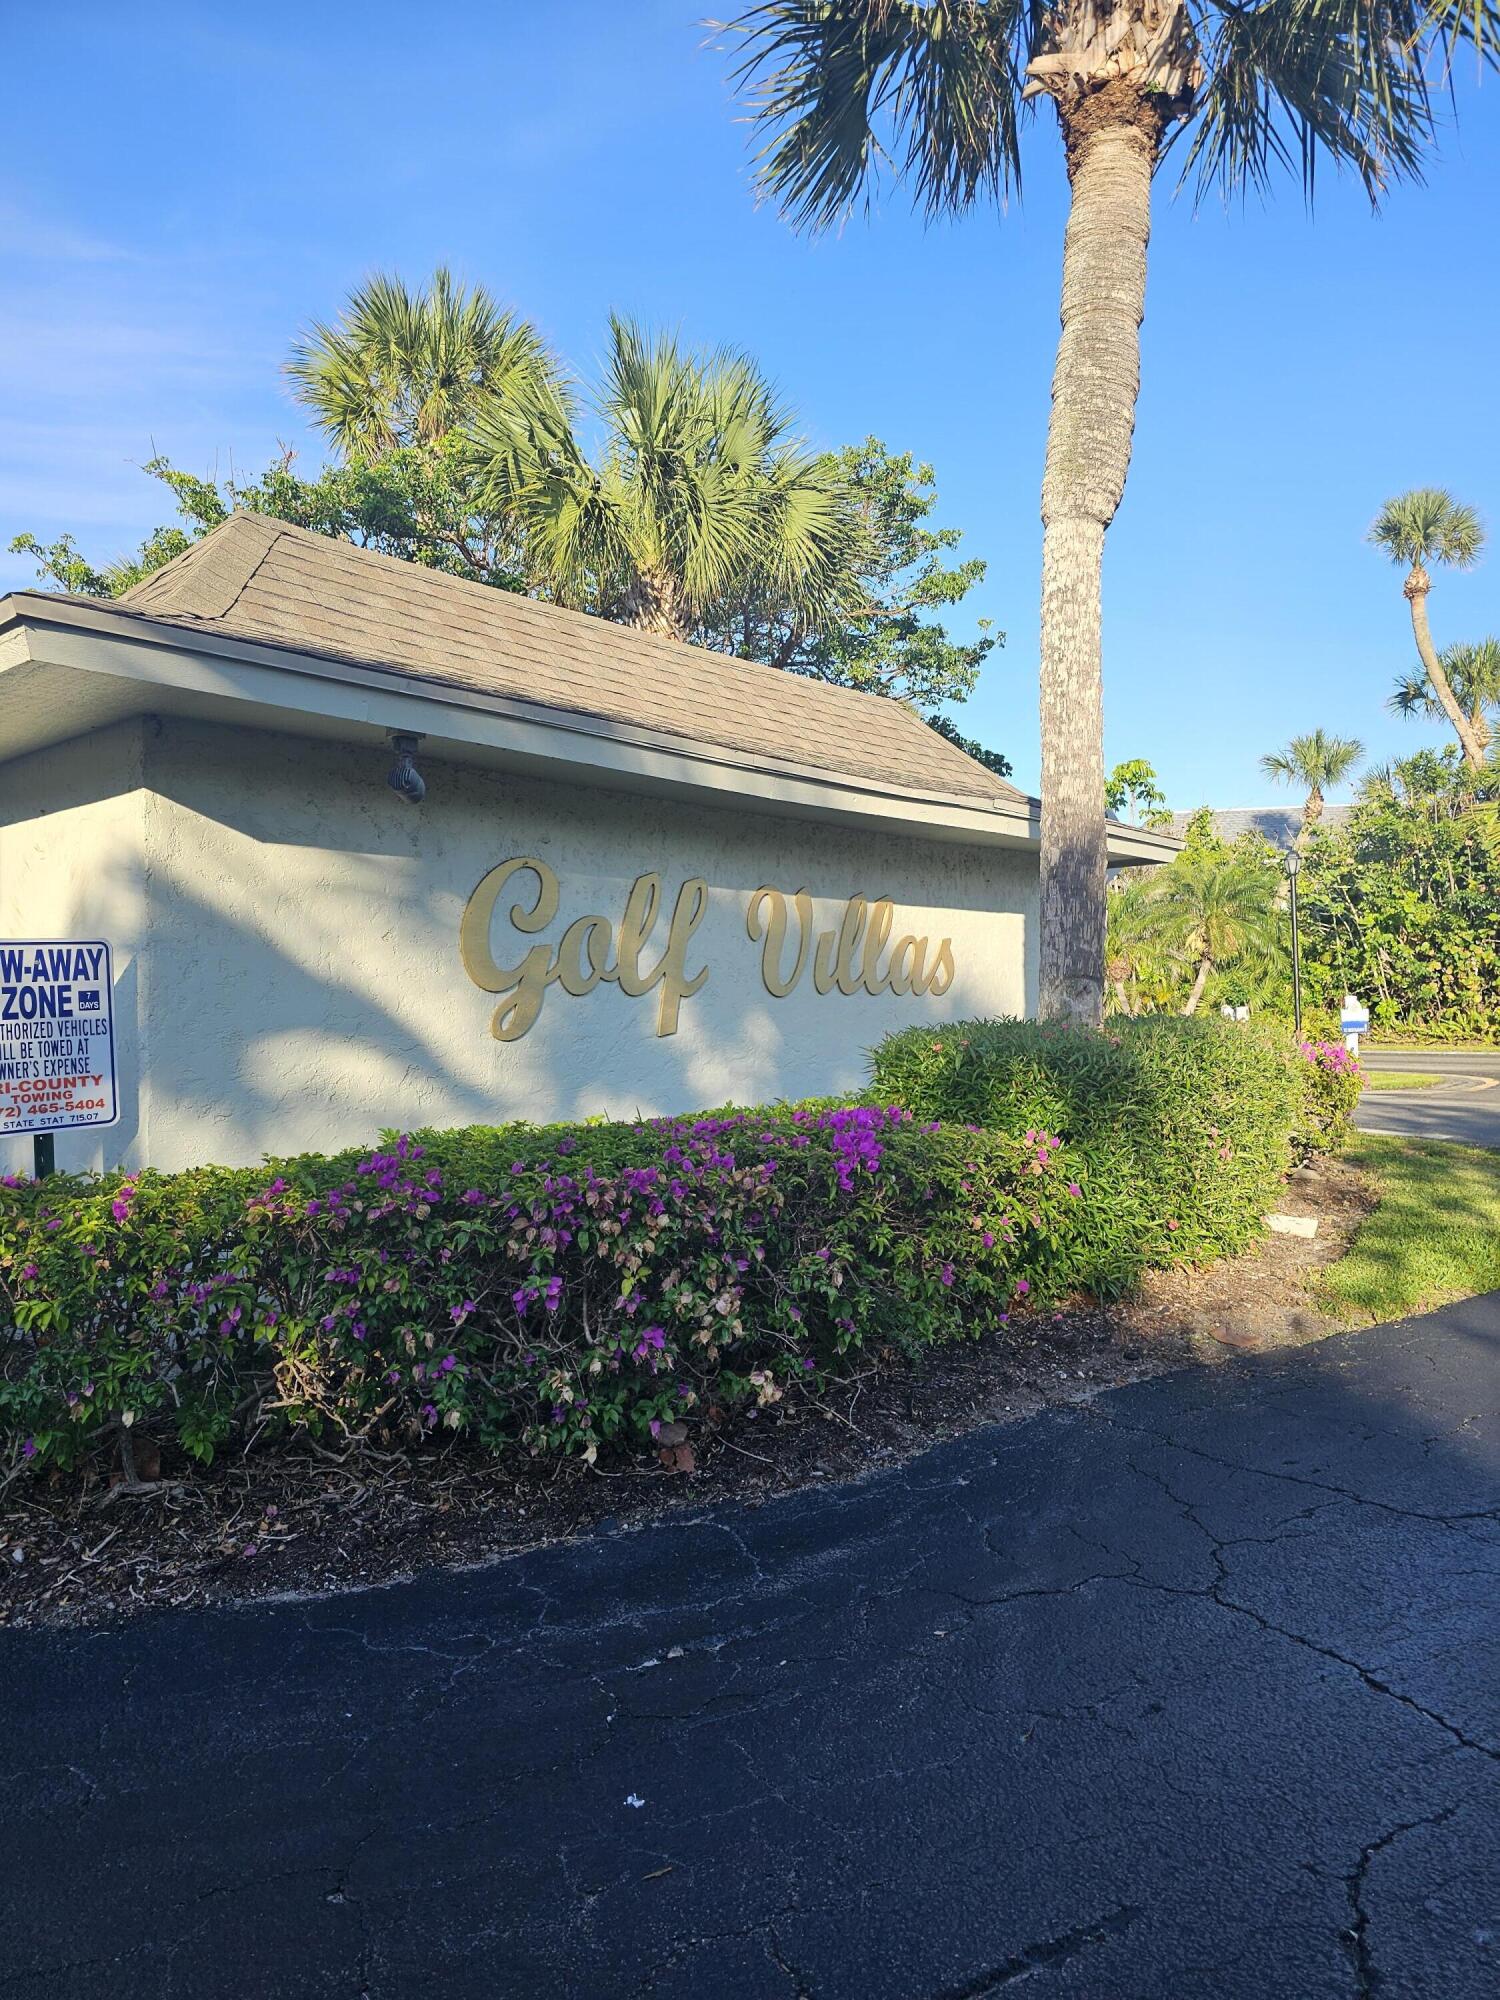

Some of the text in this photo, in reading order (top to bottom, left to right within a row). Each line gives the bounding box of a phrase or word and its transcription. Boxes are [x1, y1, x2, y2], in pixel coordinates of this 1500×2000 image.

[460, 855, 956, 1042] Golf Villas
[1, 985, 73, 1020] ZONE
[80, 1001, 99, 1009] DAYS
[86, 992, 91, 1000] 7
[57, 1018, 108, 1037] VEHICLES
[20, 1041, 34, 1059] BE
[38, 1039, 73, 1058] TOWED
[77, 1038, 89, 1055] AT
[44, 1056, 91, 1077] EXPENSE
[11, 1090, 73, 1104] TOWING
[27, 1098, 105, 1115] 465-5404
[3, 1112, 99, 1129] STATE STAT 715.07
